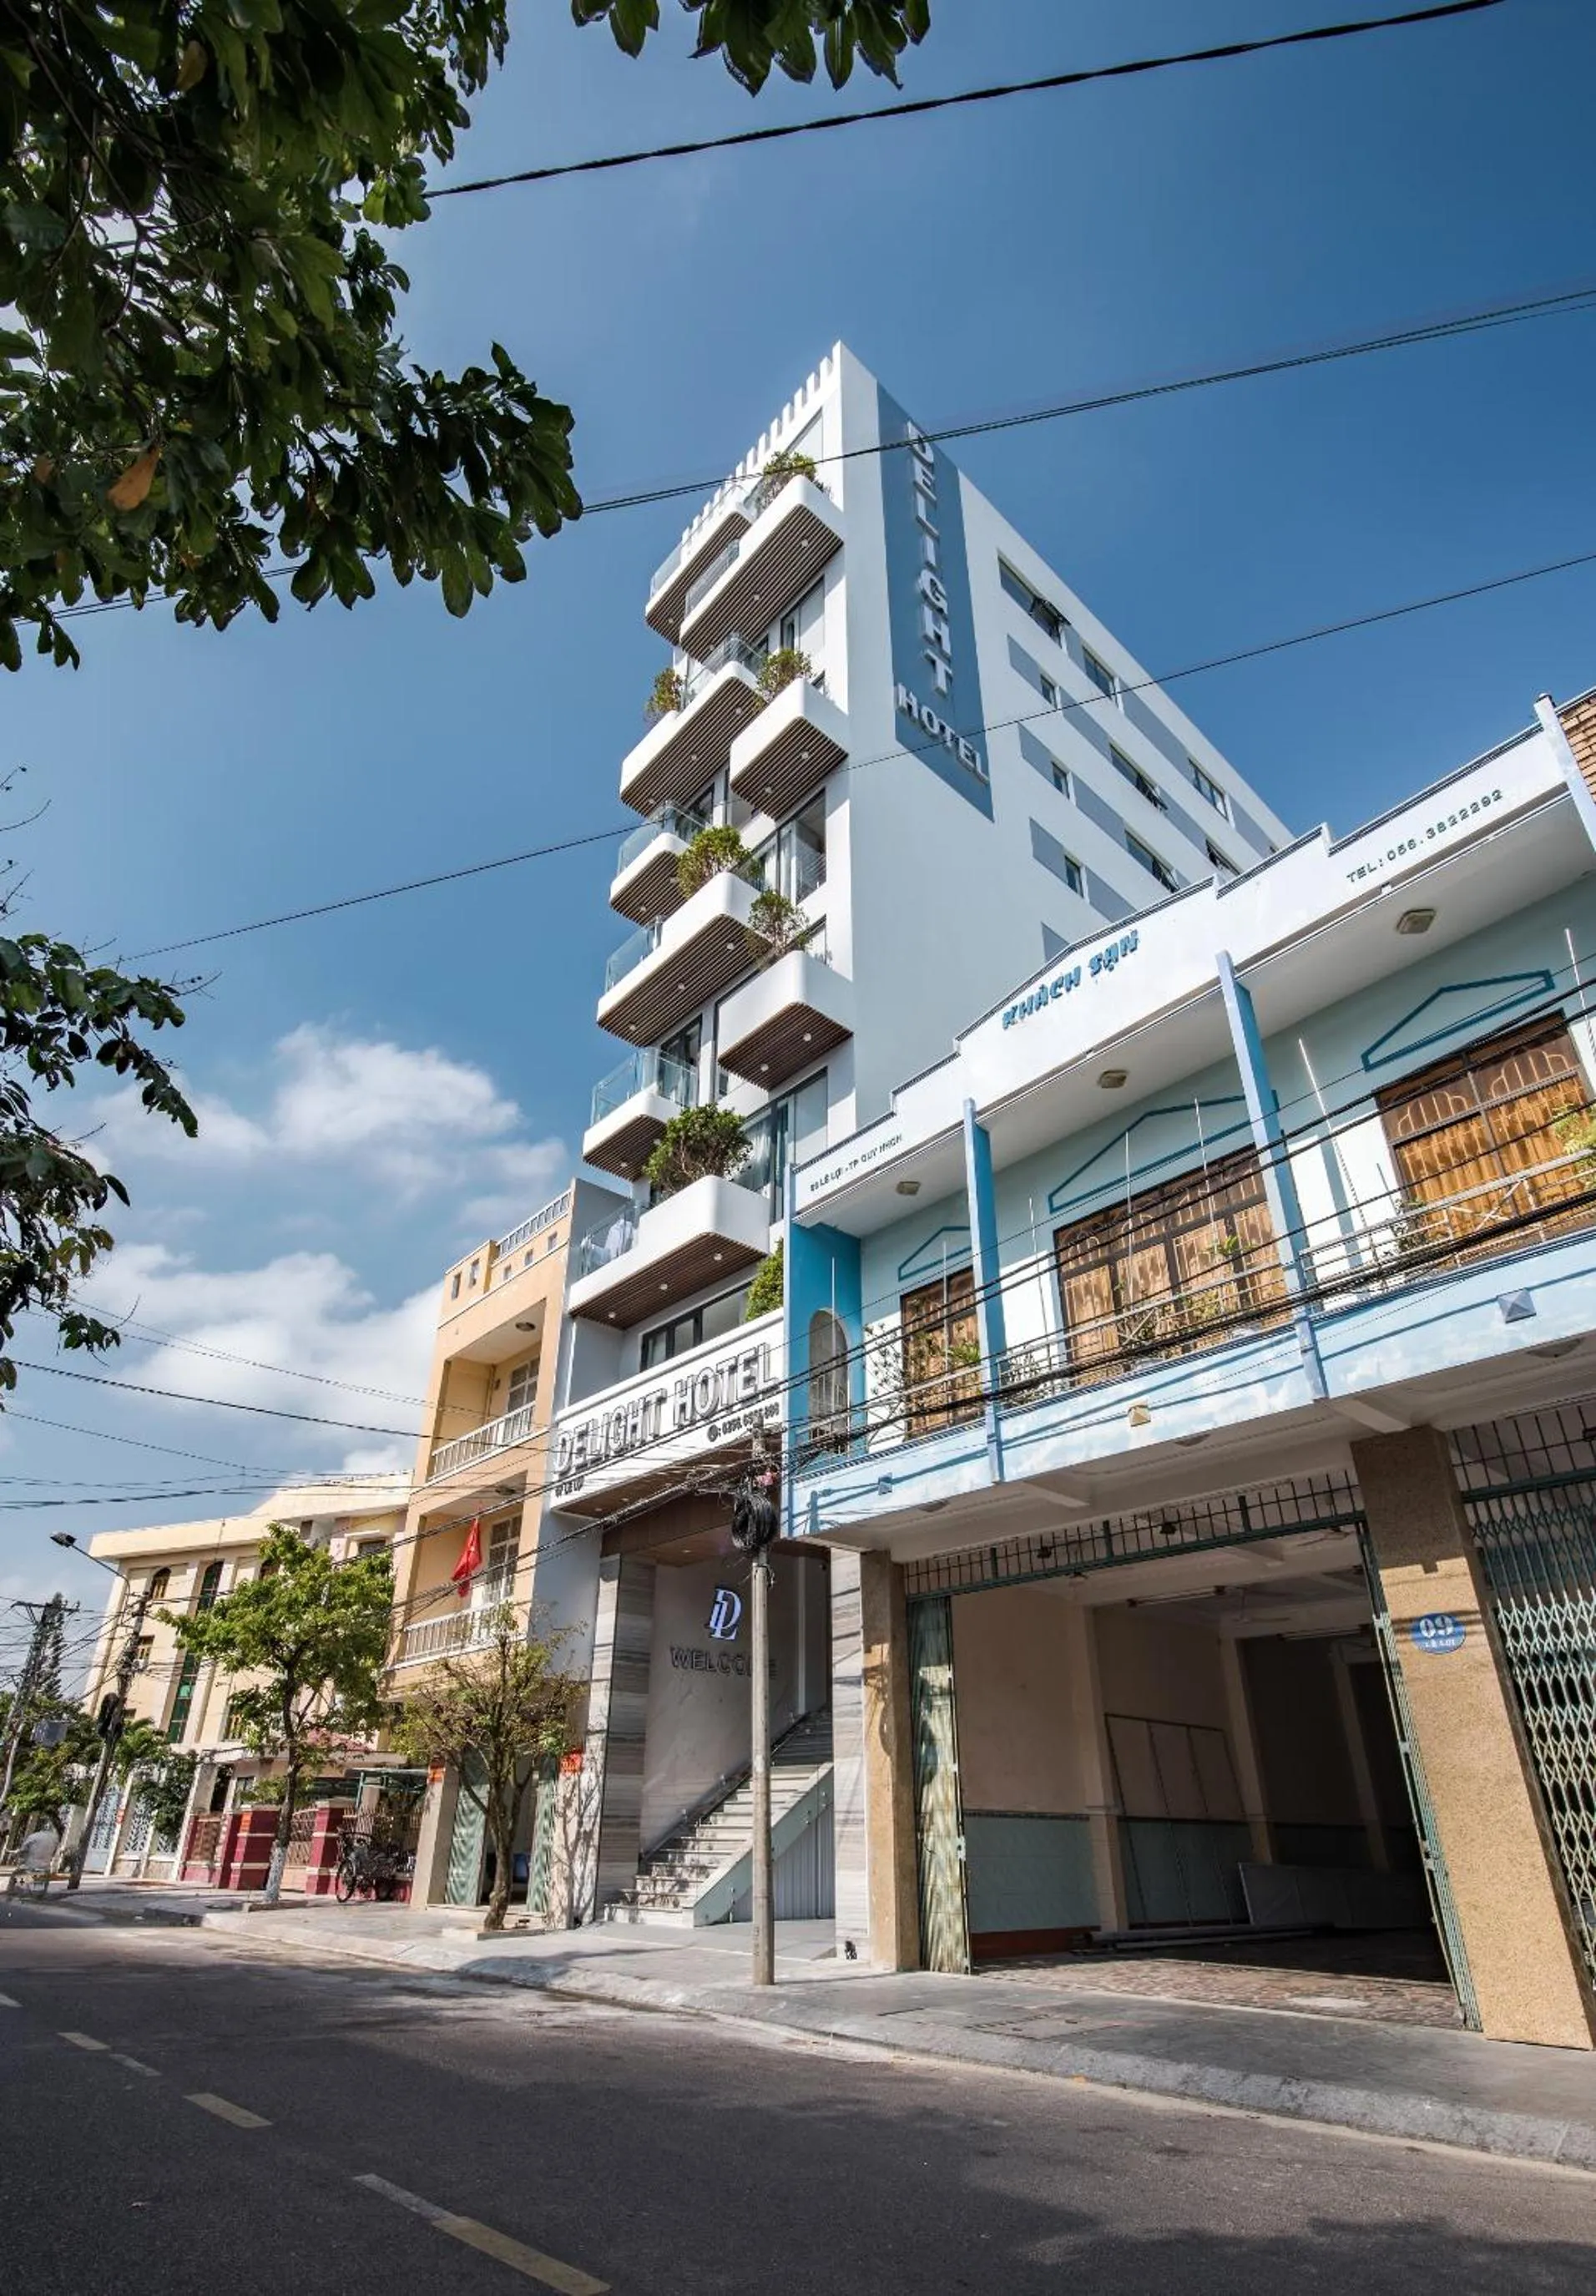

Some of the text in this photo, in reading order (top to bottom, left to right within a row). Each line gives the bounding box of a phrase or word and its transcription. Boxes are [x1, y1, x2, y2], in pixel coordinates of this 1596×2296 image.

[907, 420, 953, 697] DELIGHT
[894, 681, 990, 785] HOTEL
[1002, 929, 1139, 1030] KHÁCH SẠN
[554, 1342, 780, 1477] DELIGHT HOTEL
[669, 1646, 777, 1679] WELCOE
[1419, 1616, 1453, 1638] 09
